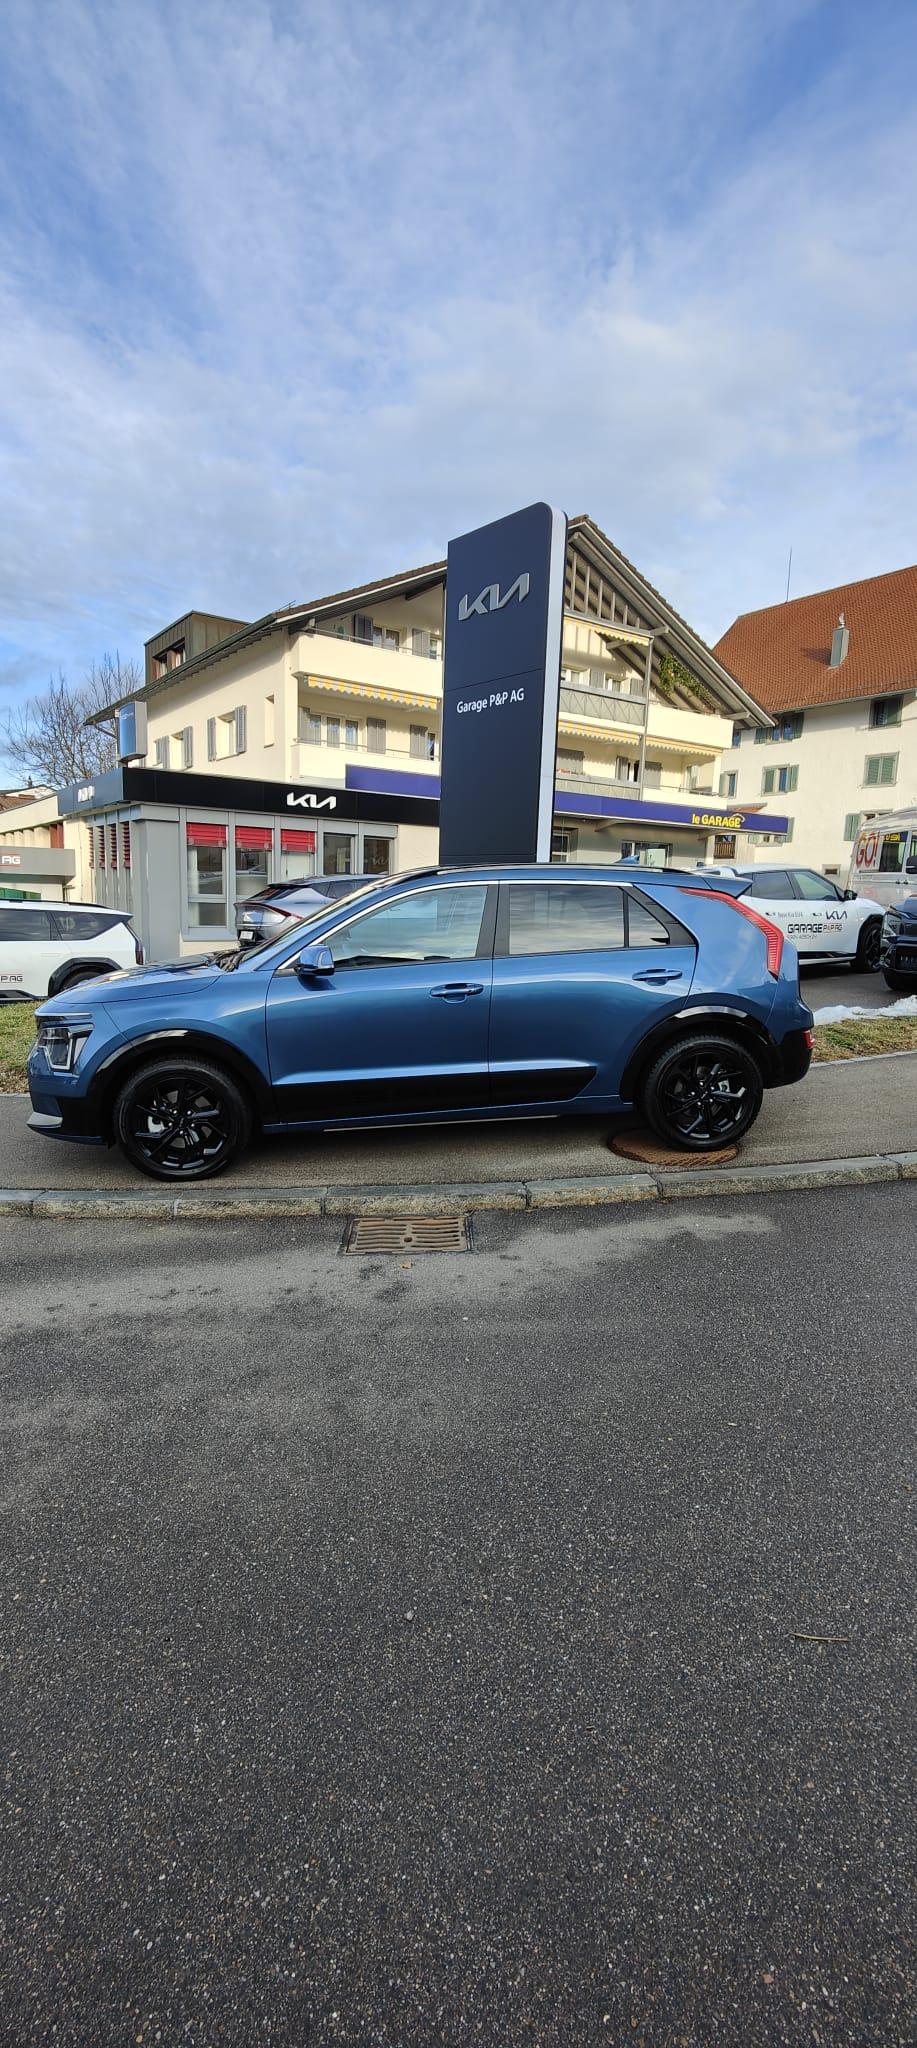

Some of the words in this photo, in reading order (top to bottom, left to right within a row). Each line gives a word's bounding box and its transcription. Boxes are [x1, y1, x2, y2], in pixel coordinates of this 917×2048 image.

[458, 572, 530, 621] KIA
[456, 698, 488, 714] Garage
[489, 691, 508, 707] P&P
[509, 687, 525, 703] AG
[286, 791, 337, 810] KIA
[691, 813, 700, 825] le
[701, 814, 742, 828] GARAGE
[1, 855, 21, 865] AG
[825, 910, 848, 920] KIA
[787, 923, 823, 934] GARAGE
